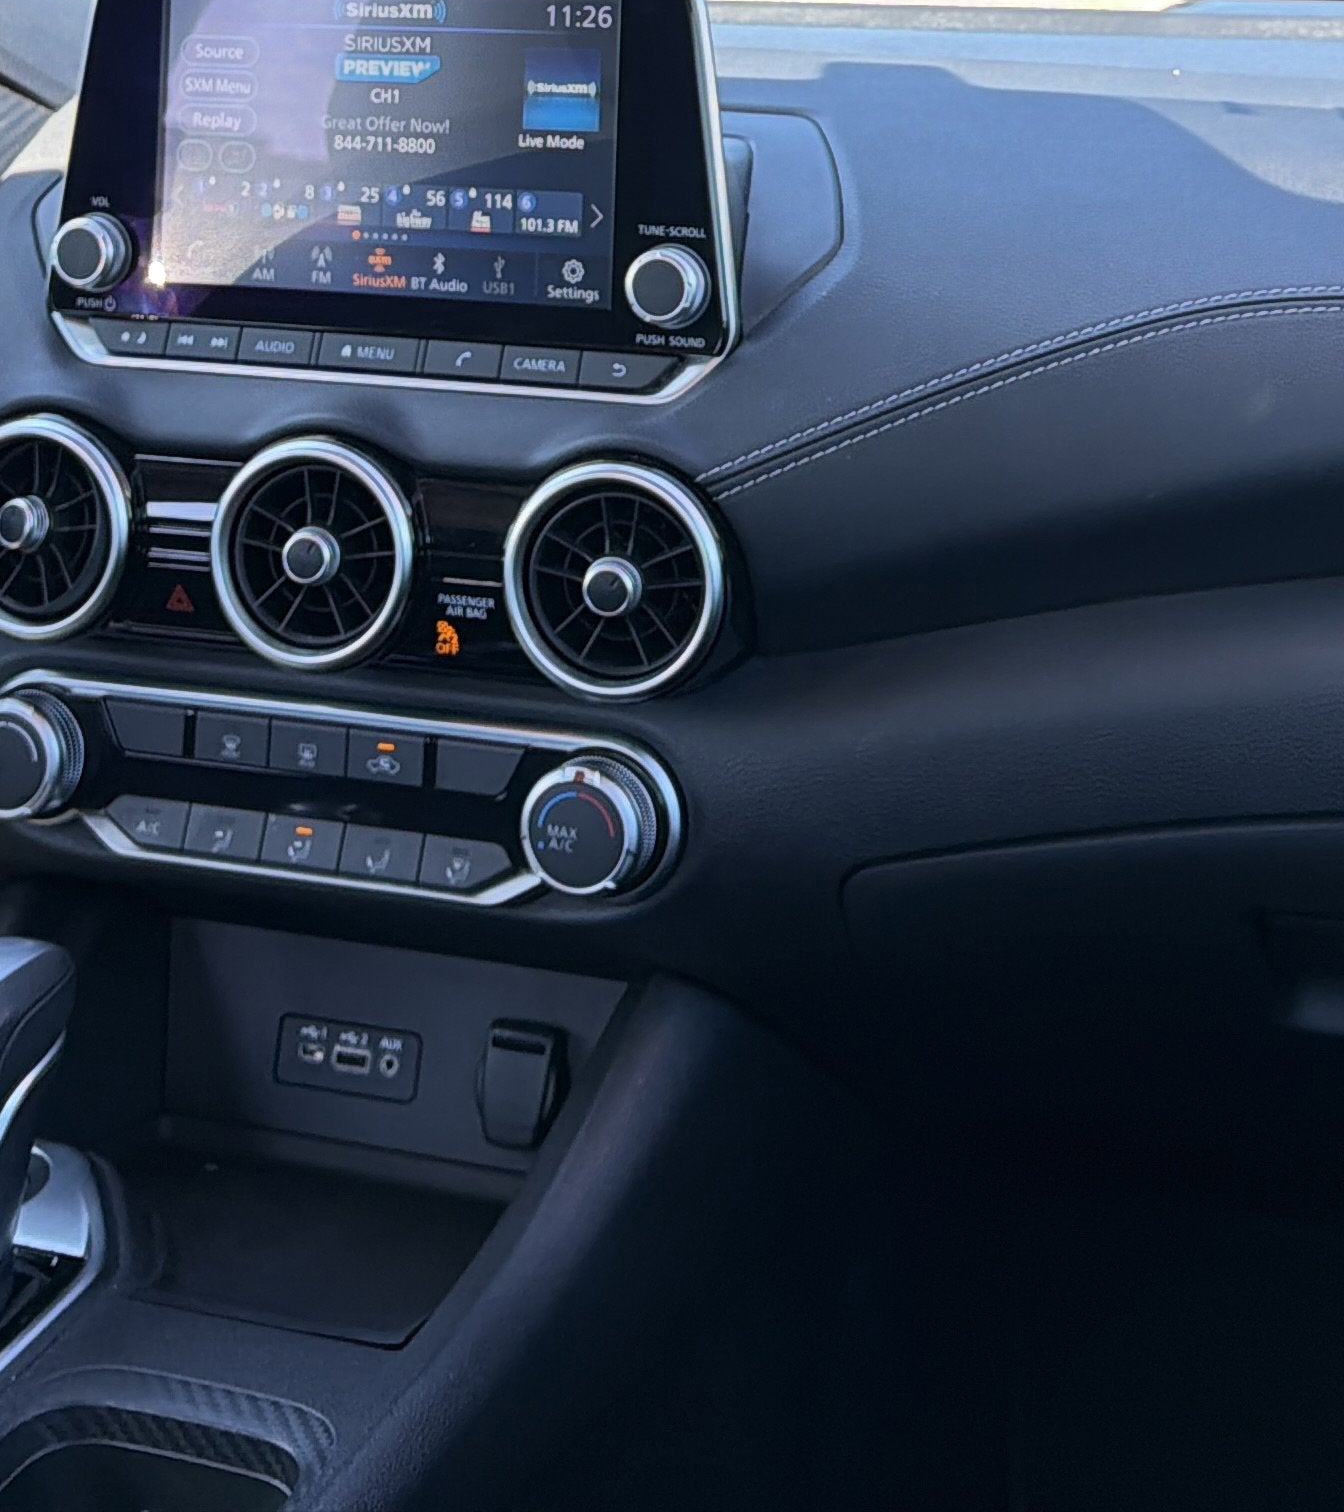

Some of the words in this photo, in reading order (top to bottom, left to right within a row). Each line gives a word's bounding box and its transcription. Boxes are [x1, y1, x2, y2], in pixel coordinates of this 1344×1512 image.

[545, 5, 613, 28] 11:26
[196, 43, 244, 59] Source
[344, 34, 431, 53] SIRIUSXM
[343, 59, 431, 78] PREVIEW
[185, 77, 214, 93] SXM
[217, 78, 251, 94] Menu
[370, 88, 399, 104] CH1
[193, 112, 242, 131] Replay
[323, 114, 362, 129] Great
[366, 115, 406, 131] Offer
[410, 118, 450, 135] Now!
[334, 134, 436, 154] 844-711-8800
[518, 133, 544, 149] Live
[546, 134, 585, 149] Mode
[241, 181, 251, 197] 2
[305, 184, 315, 200] 8
[360, 186, 380, 203] 25
[91, 196, 110, 208] VOL
[426, 190, 446, 206] 56
[485, 192, 513, 209] 114
[520, 217, 555, 232] 101.3
[557, 219, 578, 233] FM
[252, 268, 275, 281] AM
[311, 270, 332, 284] FM
[352, 273, 407, 288] SiriusXM
[410, 276, 427, 289] BT
[429, 277, 468, 293] Audio
[483, 281, 515, 295] USB1
[76, 296, 103, 308] PUSH
[547, 285, 600, 304] Settings
[254, 339, 296, 355] AUDIO
[636, 333, 666, 346] PUSH
[669, 336, 706, 348] SOUND
[356, 345, 395, 360] MENU
[513, 357, 566, 373] CAMERA
[437, 593, 495, 609] PASSENGER
[445, 604, 464, 617] AIR
[465, 607, 488, 620] BAG
[436, 642, 459, 656] OFF
[137, 819, 160, 834] A/C
[547, 823, 578, 841] MAX
[548, 837, 574, 854] A/C
[380, 1035, 402, 1051] AUX
